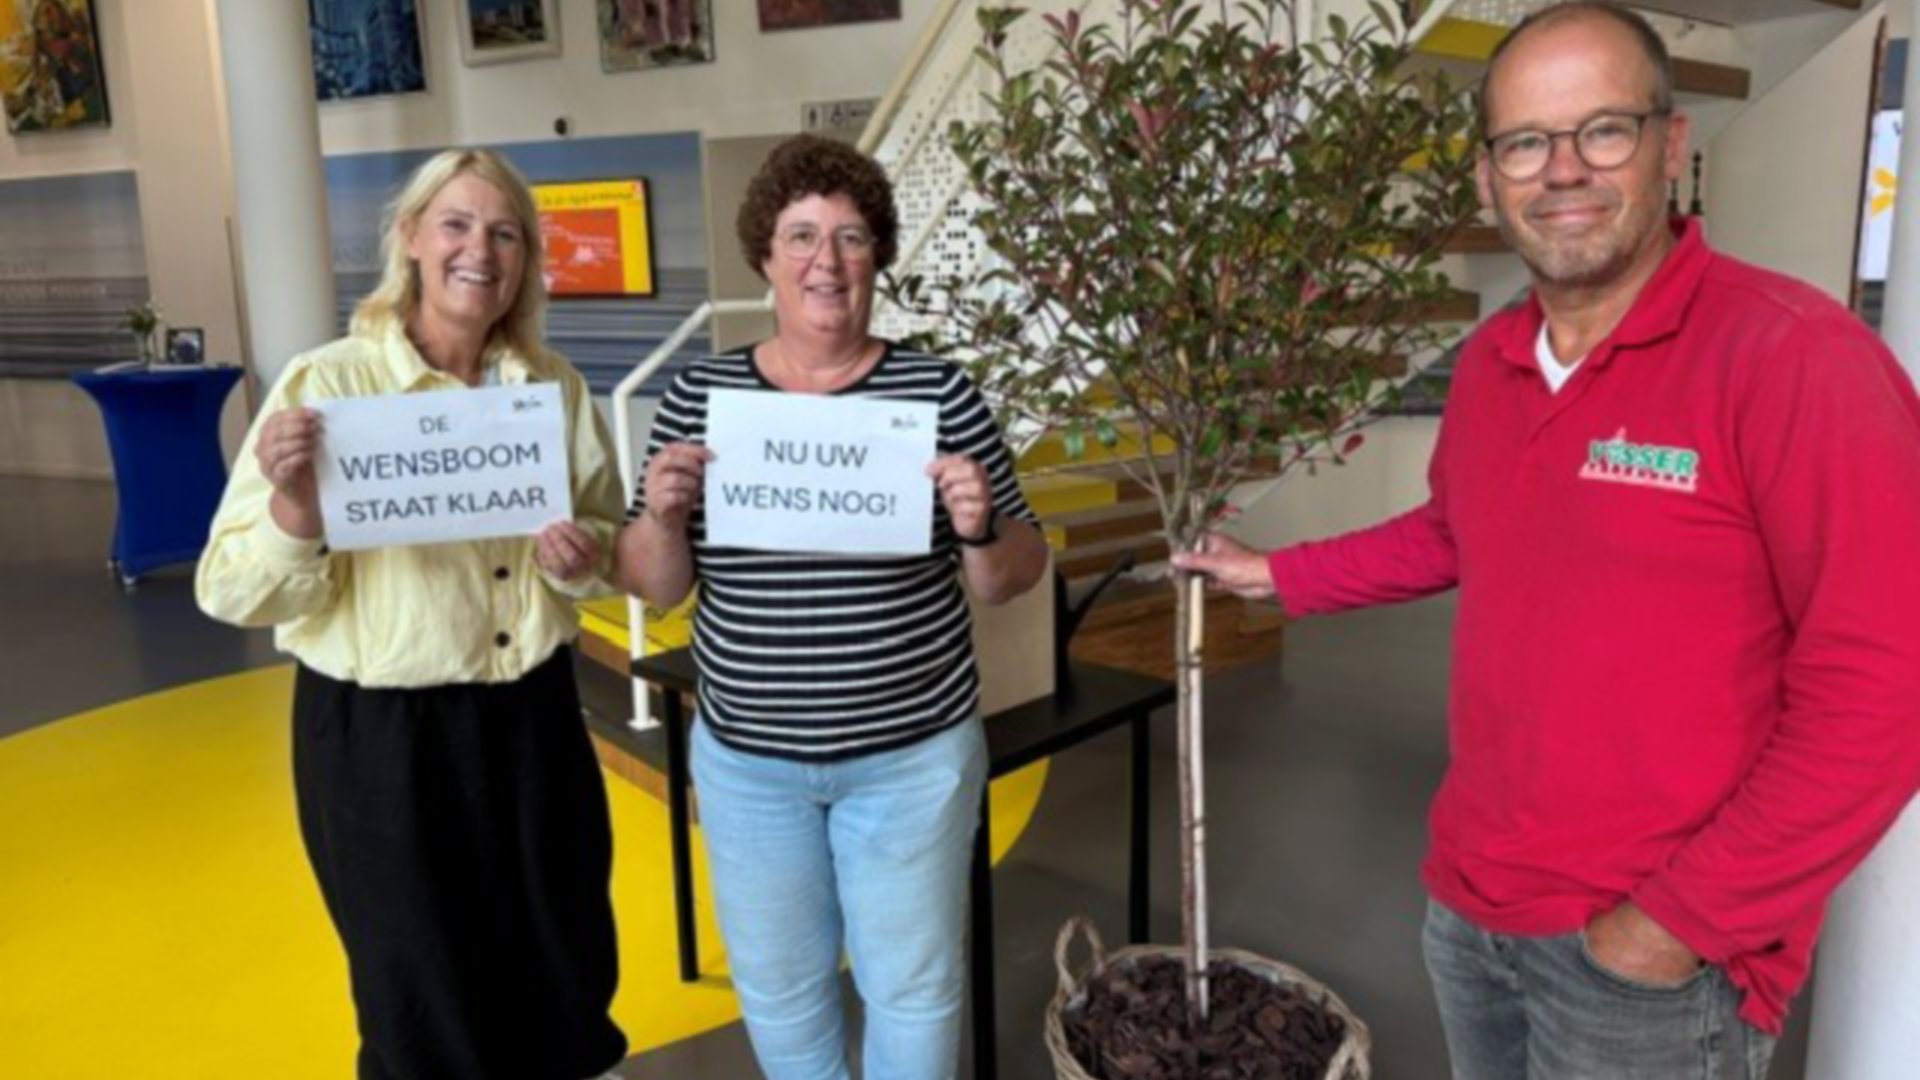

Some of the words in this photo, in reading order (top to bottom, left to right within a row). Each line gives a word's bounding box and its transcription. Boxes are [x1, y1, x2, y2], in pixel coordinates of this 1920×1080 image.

[419, 417, 450, 435] DE
[339, 441, 541, 482] WENSBOOM
[763, 438, 808, 465] NU
[815, 443, 868, 468] UW
[345, 494, 437, 524] STAAT
[448, 486, 548, 514] KLAAR
[721, 482, 812, 512] WENS
[817, 489, 897, 516] NOG!
